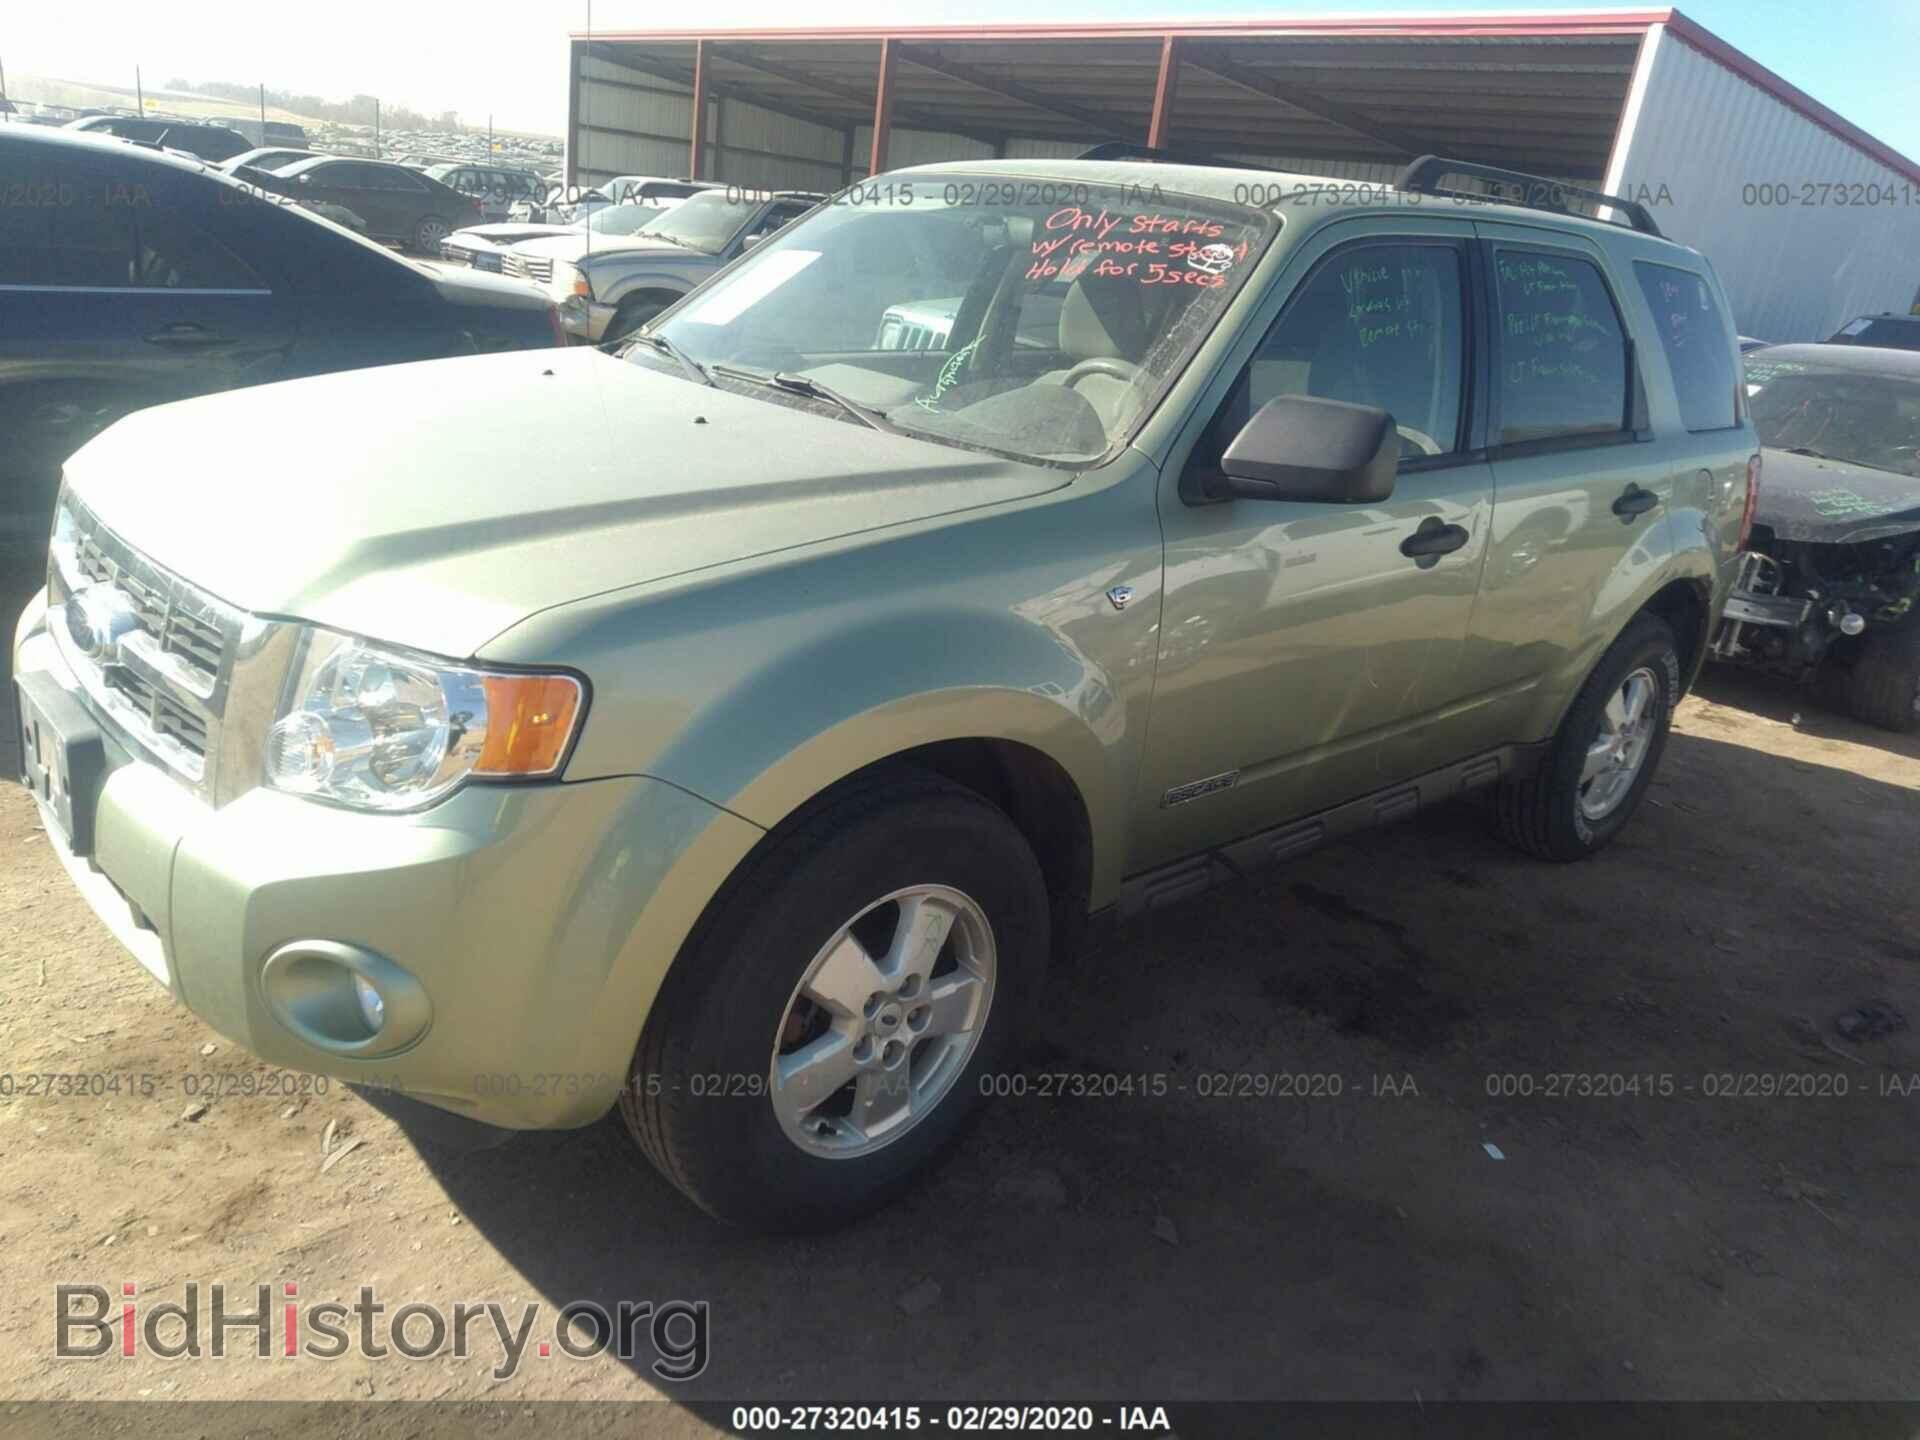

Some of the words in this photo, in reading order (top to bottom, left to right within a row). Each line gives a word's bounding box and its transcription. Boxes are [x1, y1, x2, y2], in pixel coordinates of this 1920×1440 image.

[1046, 208, 1122, 239] Only
[1070, 239, 1160, 256] remote
[1025, 258, 1088, 280] Hold
[1093, 258, 1139, 276] for
